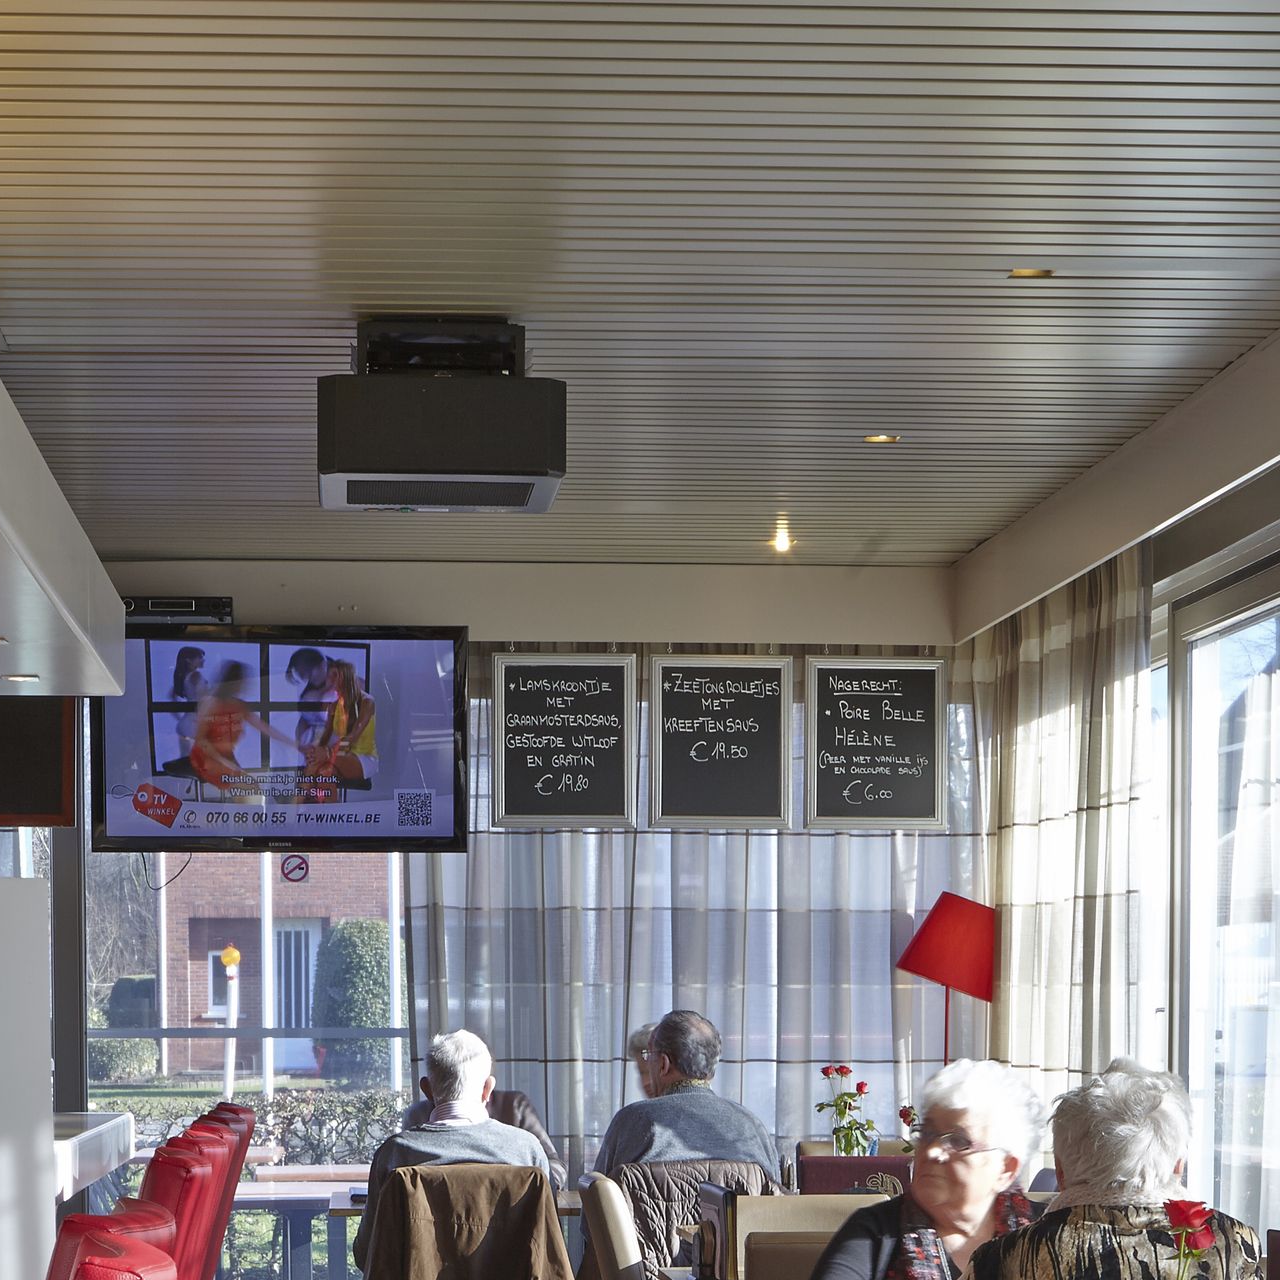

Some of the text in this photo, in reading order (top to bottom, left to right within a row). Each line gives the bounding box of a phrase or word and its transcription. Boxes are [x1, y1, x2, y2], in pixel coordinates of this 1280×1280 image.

[546, 696, 575, 708] MET
[701, 697, 735, 711] MET
[882, 699, 926, 723] BELLE
[506, 733, 566, 749] GESTOOFDE
[835, 726, 896, 747] HÉLÈNE
[711, 741, 749, 760] 19.50
[526, 755, 543, 767] EN
[852, 755, 871, 764] MET
[834, 766, 846, 775] EN
[296, 774, 314, 783] niet
[316, 774, 340, 783] druk.
[557, 772, 589, 793] 19.80
[231, 788, 254, 796] Want
[272, 788, 280, 796] is
[295, 788, 307, 796] Fir
[310, 788, 331, 796] Slim
[864, 783, 893, 801] 6.00
[153, 794, 167, 805] TV
[147, 807, 175, 816] WINKEL
[206, 812, 381, 824] 070 66 00 55 TV-WINKEL.BE
